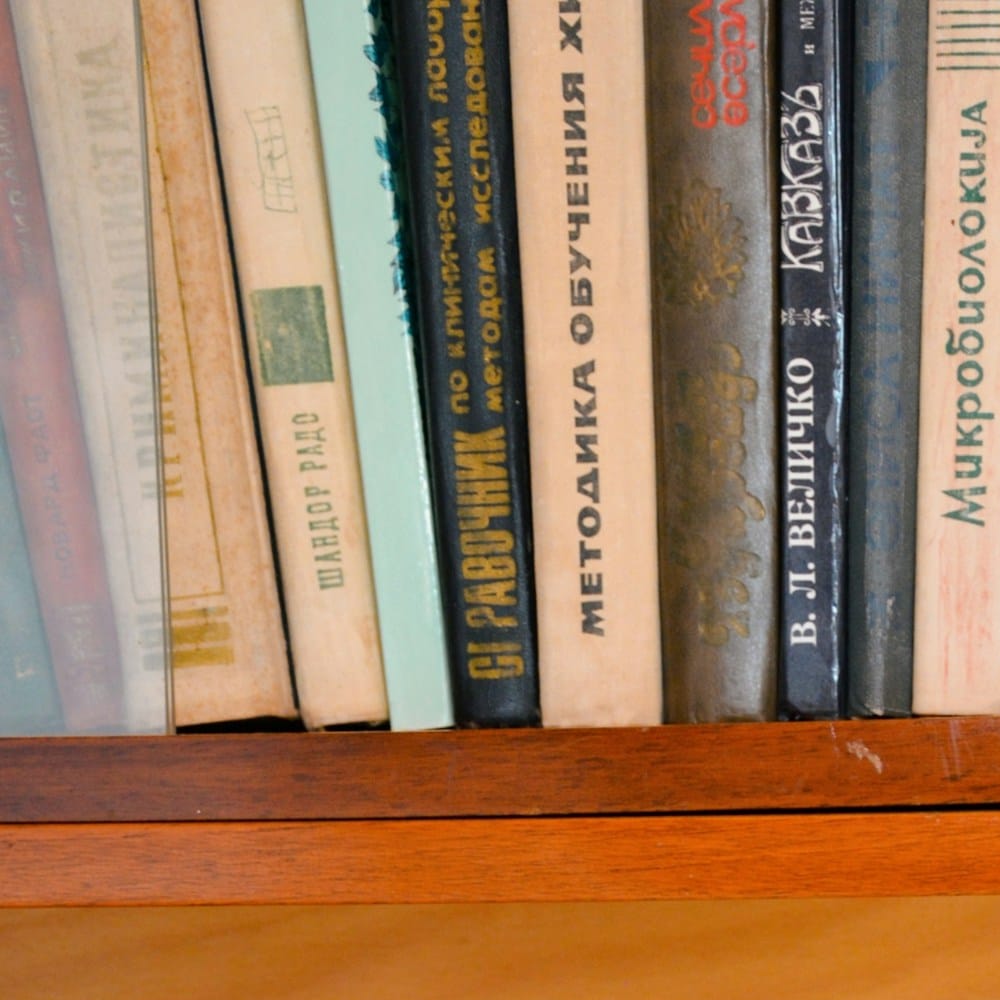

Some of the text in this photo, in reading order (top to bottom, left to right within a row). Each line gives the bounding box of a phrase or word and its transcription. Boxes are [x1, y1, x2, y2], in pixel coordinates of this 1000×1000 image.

[427, 117, 466, 358] клиническим
[560, 71, 596, 345] ОБУЧЕНИЯ
[447, 370, 471, 413] по
[477, 248, 504, 412] методам
[291, 412, 344, 590] ШАНДОР РАДО
[571, 359, 605, 637] МЕТОДИКА
[783, 356, 817, 549] ВЕЛИЧКО
[788, 561, 818, 599] Л.
[788, 613, 818, 646] В.
